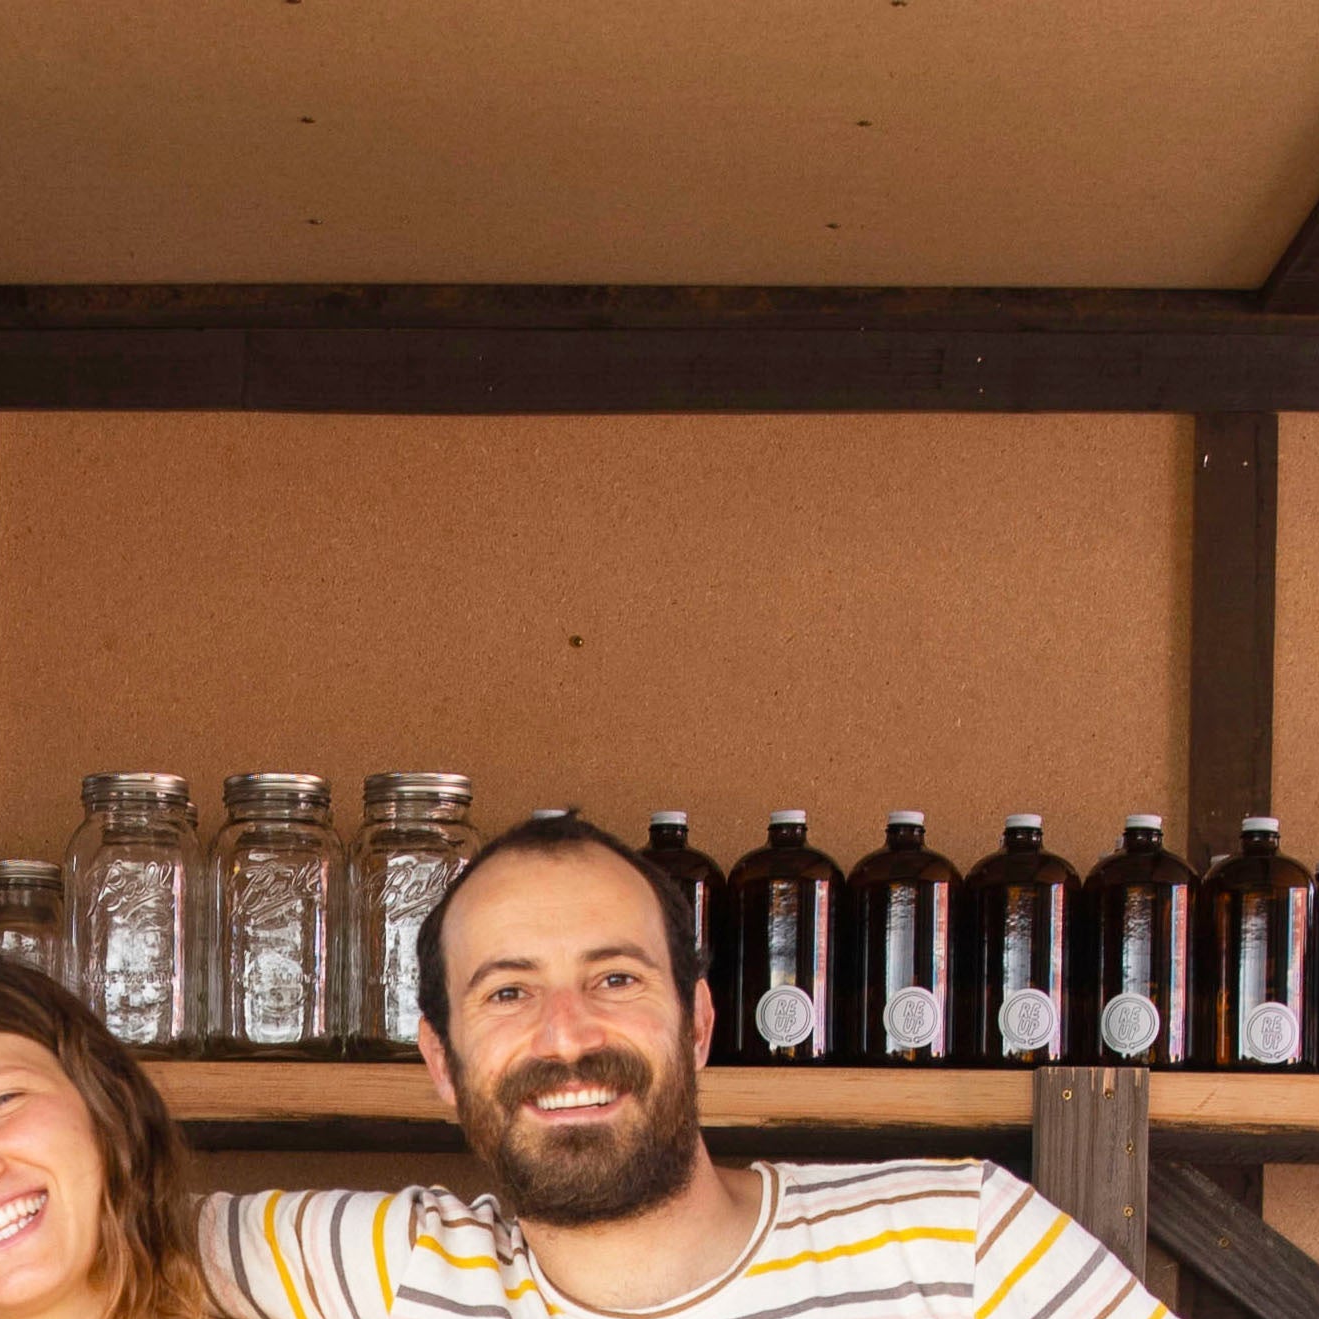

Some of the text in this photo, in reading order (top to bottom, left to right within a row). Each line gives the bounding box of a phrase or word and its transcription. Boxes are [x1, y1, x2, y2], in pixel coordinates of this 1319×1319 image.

[776, 1000, 797, 1015] RE
[903, 1000, 924, 1016] RE
[1019, 1002, 1041, 1018] RE
[1119, 1007, 1141, 1023] RE
[775, 1015, 796, 1032] UP
[903, 1016, 924, 1034] UP
[1017, 1017, 1040, 1037] UP
[1118, 1022, 1140, 1041] UP
[1261, 1016, 1283, 1033] RE
[1262, 1032, 1283, 1050] UP
